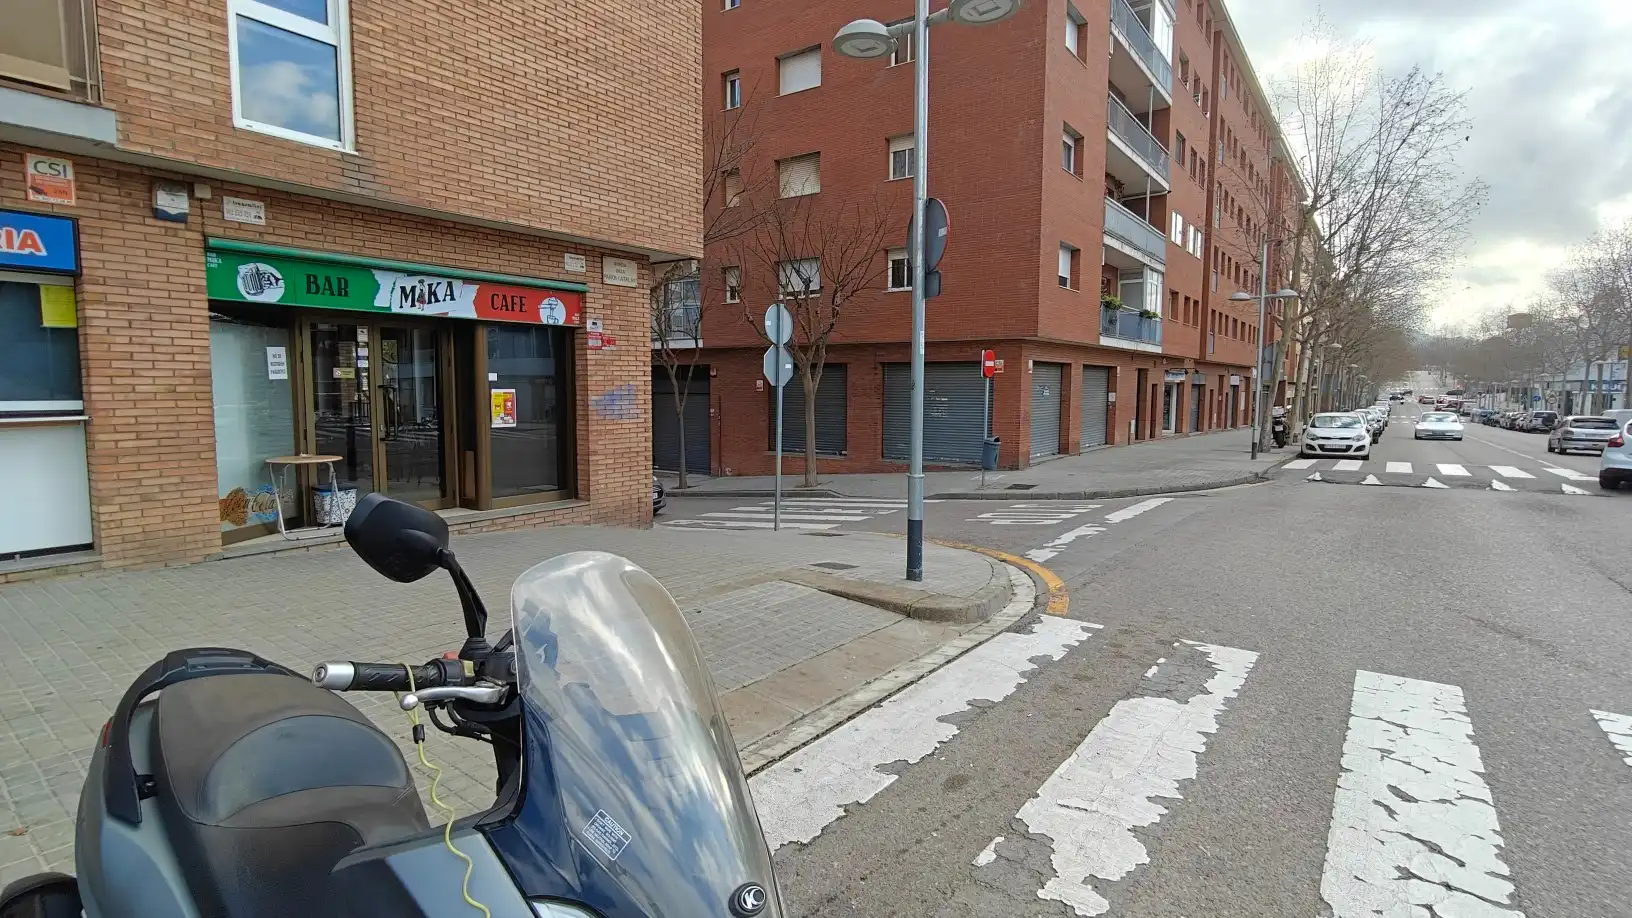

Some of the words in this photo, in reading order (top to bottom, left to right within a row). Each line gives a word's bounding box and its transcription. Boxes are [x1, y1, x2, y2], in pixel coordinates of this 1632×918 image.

[33, 160, 68, 178] CSI
[305, 273, 349, 298] BAR
[490, 293, 527, 312] CAFE
[604, 816, 624, 836] CAUTION
